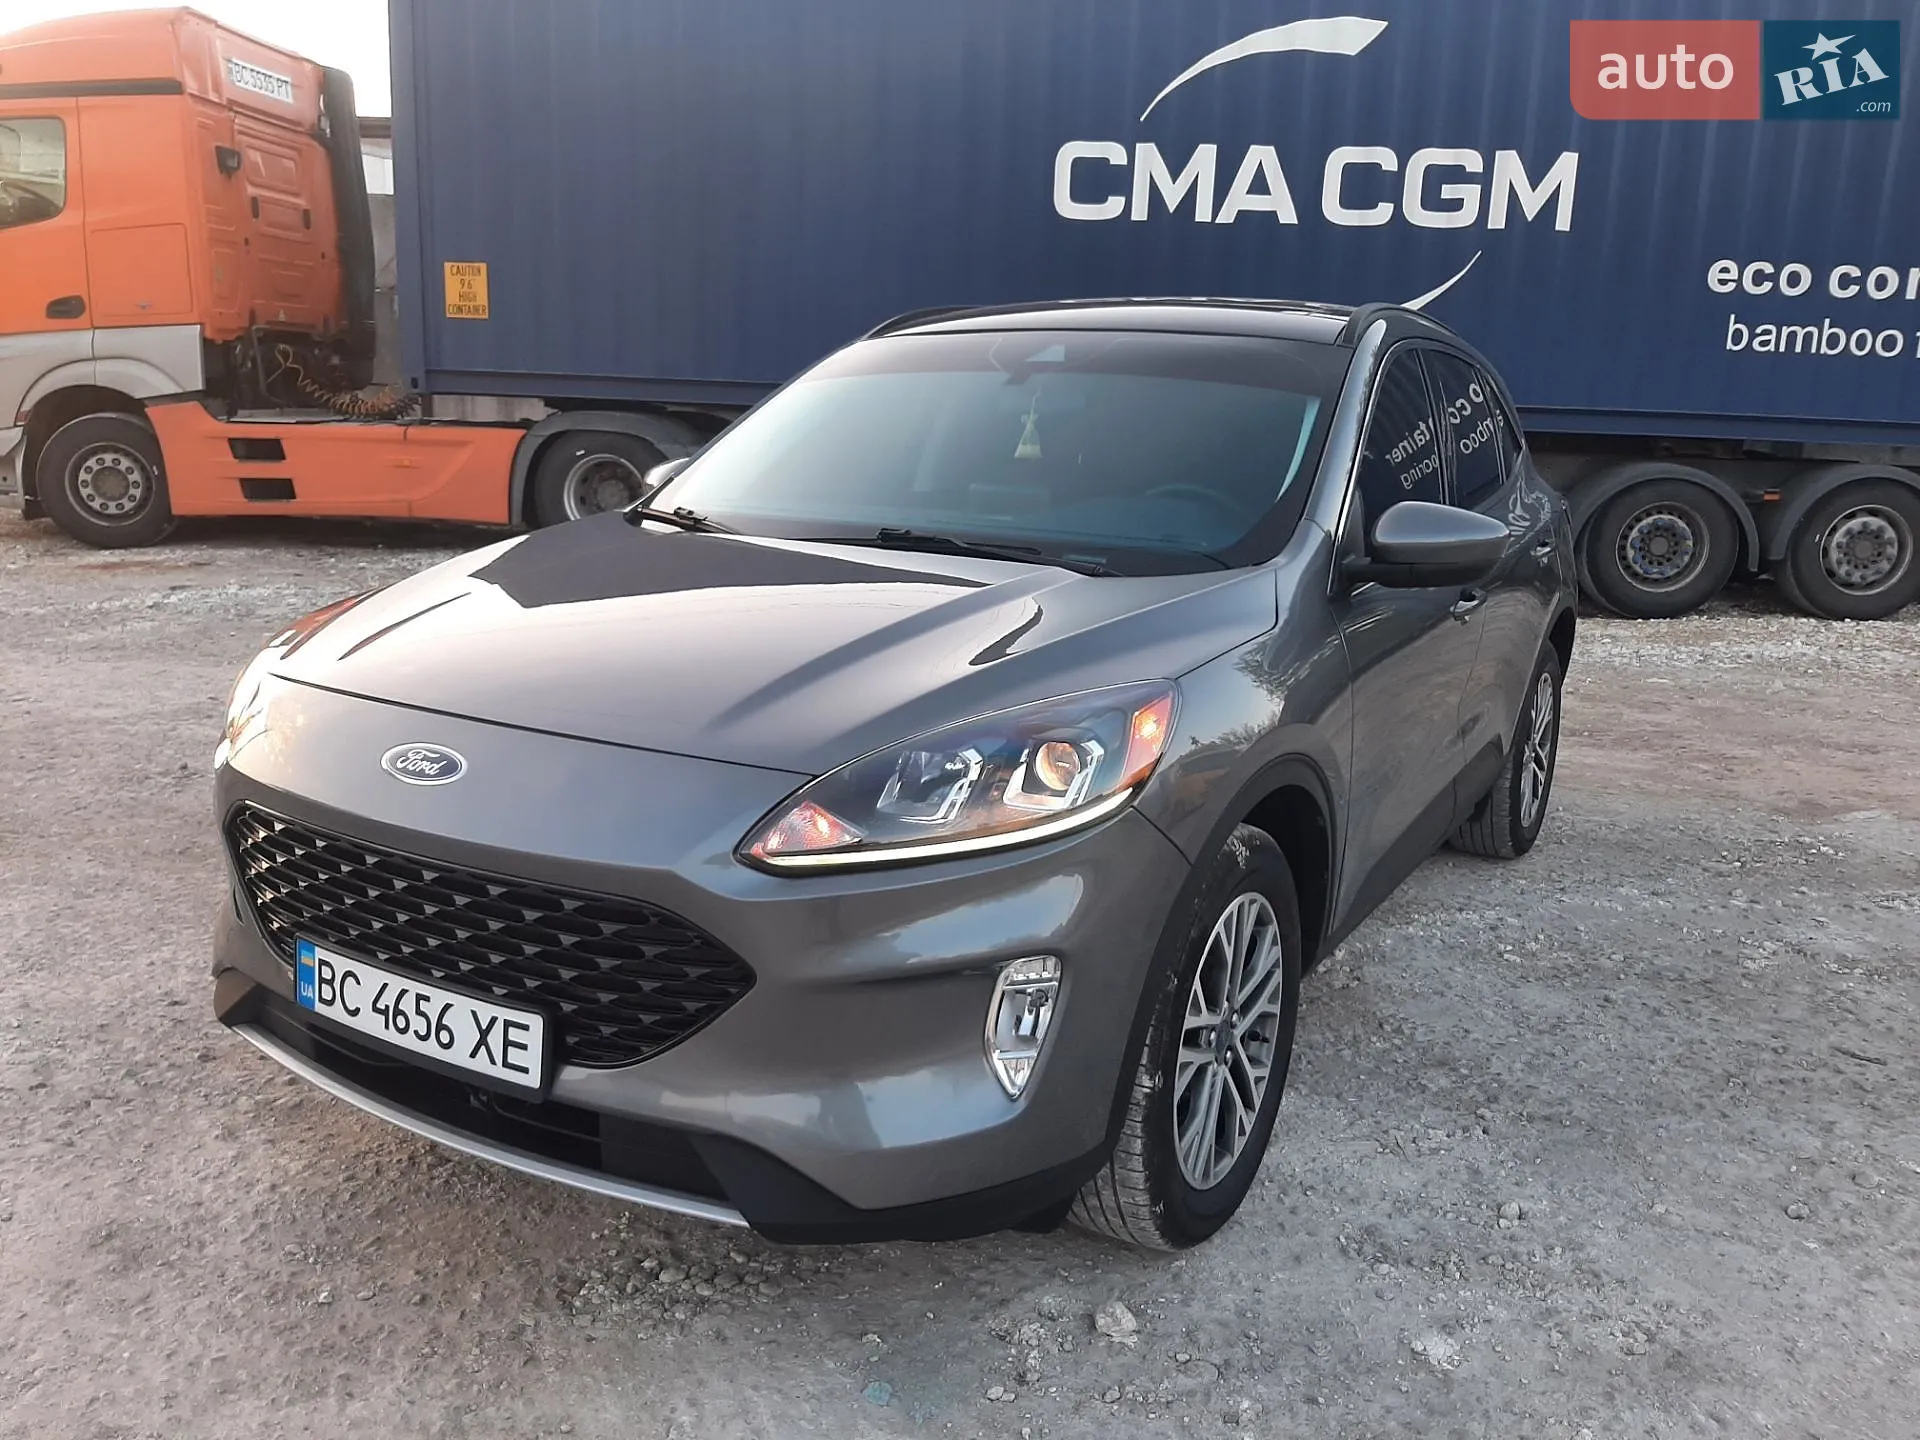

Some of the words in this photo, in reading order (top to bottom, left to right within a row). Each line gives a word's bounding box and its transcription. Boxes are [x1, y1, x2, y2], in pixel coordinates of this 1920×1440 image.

[1053, 140, 1299, 225] CMA
[1321, 146, 1580, 231] CGM
[1707, 258, 1812, 297] eco
[1725, 313, 1904, 358] bamboo
[396, 748, 448, 776] Ford
[300, 981, 314, 1000] UA
[317, 957, 362, 1018] BC
[371, 981, 456, 1051] 4656
[468, 1008, 531, 1076] XE
